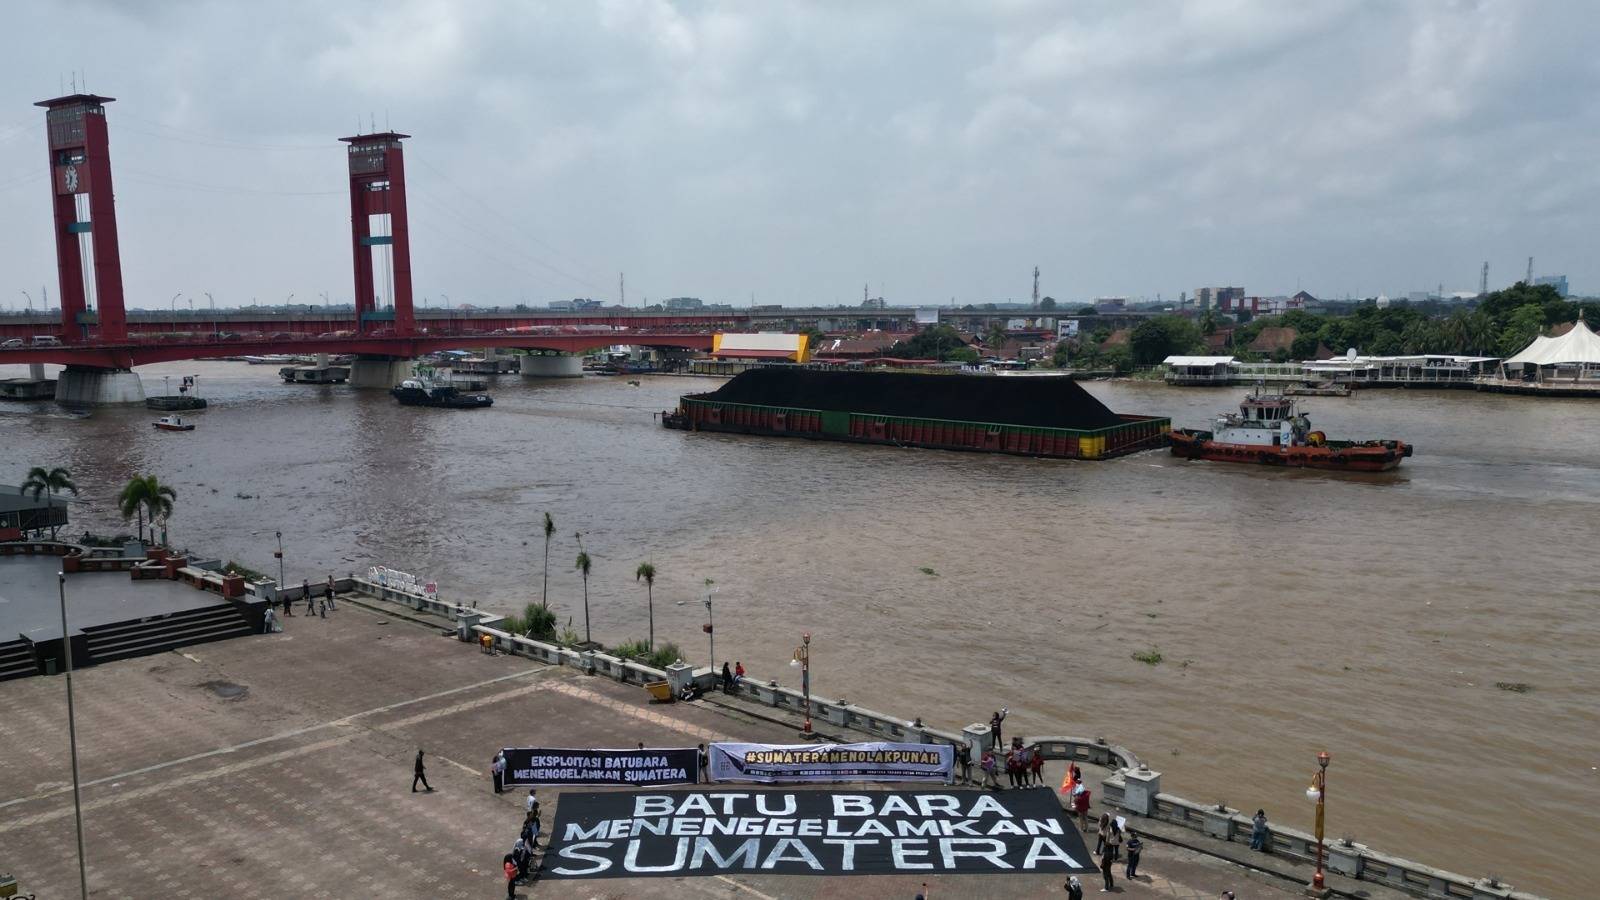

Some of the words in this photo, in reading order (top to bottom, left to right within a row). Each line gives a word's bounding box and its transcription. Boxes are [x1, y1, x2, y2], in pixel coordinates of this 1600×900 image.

[531, 756, 601, 768] EKSPLOITASI
[604, 756, 668, 768] BATUBARA
[745, 750, 940, 765] #SUMATERAMENOLAKPUNAH
[513, 769, 620, 780] MENENGGELAMKAN
[624, 768, 687, 781] SUMATERA
[632, 793, 797, 817] BATU
[832, 794, 1014, 817] BARA
[563, 817, 1065, 841] MENENGGELAMKAN
[551, 837, 1083, 875] SUMATERA
